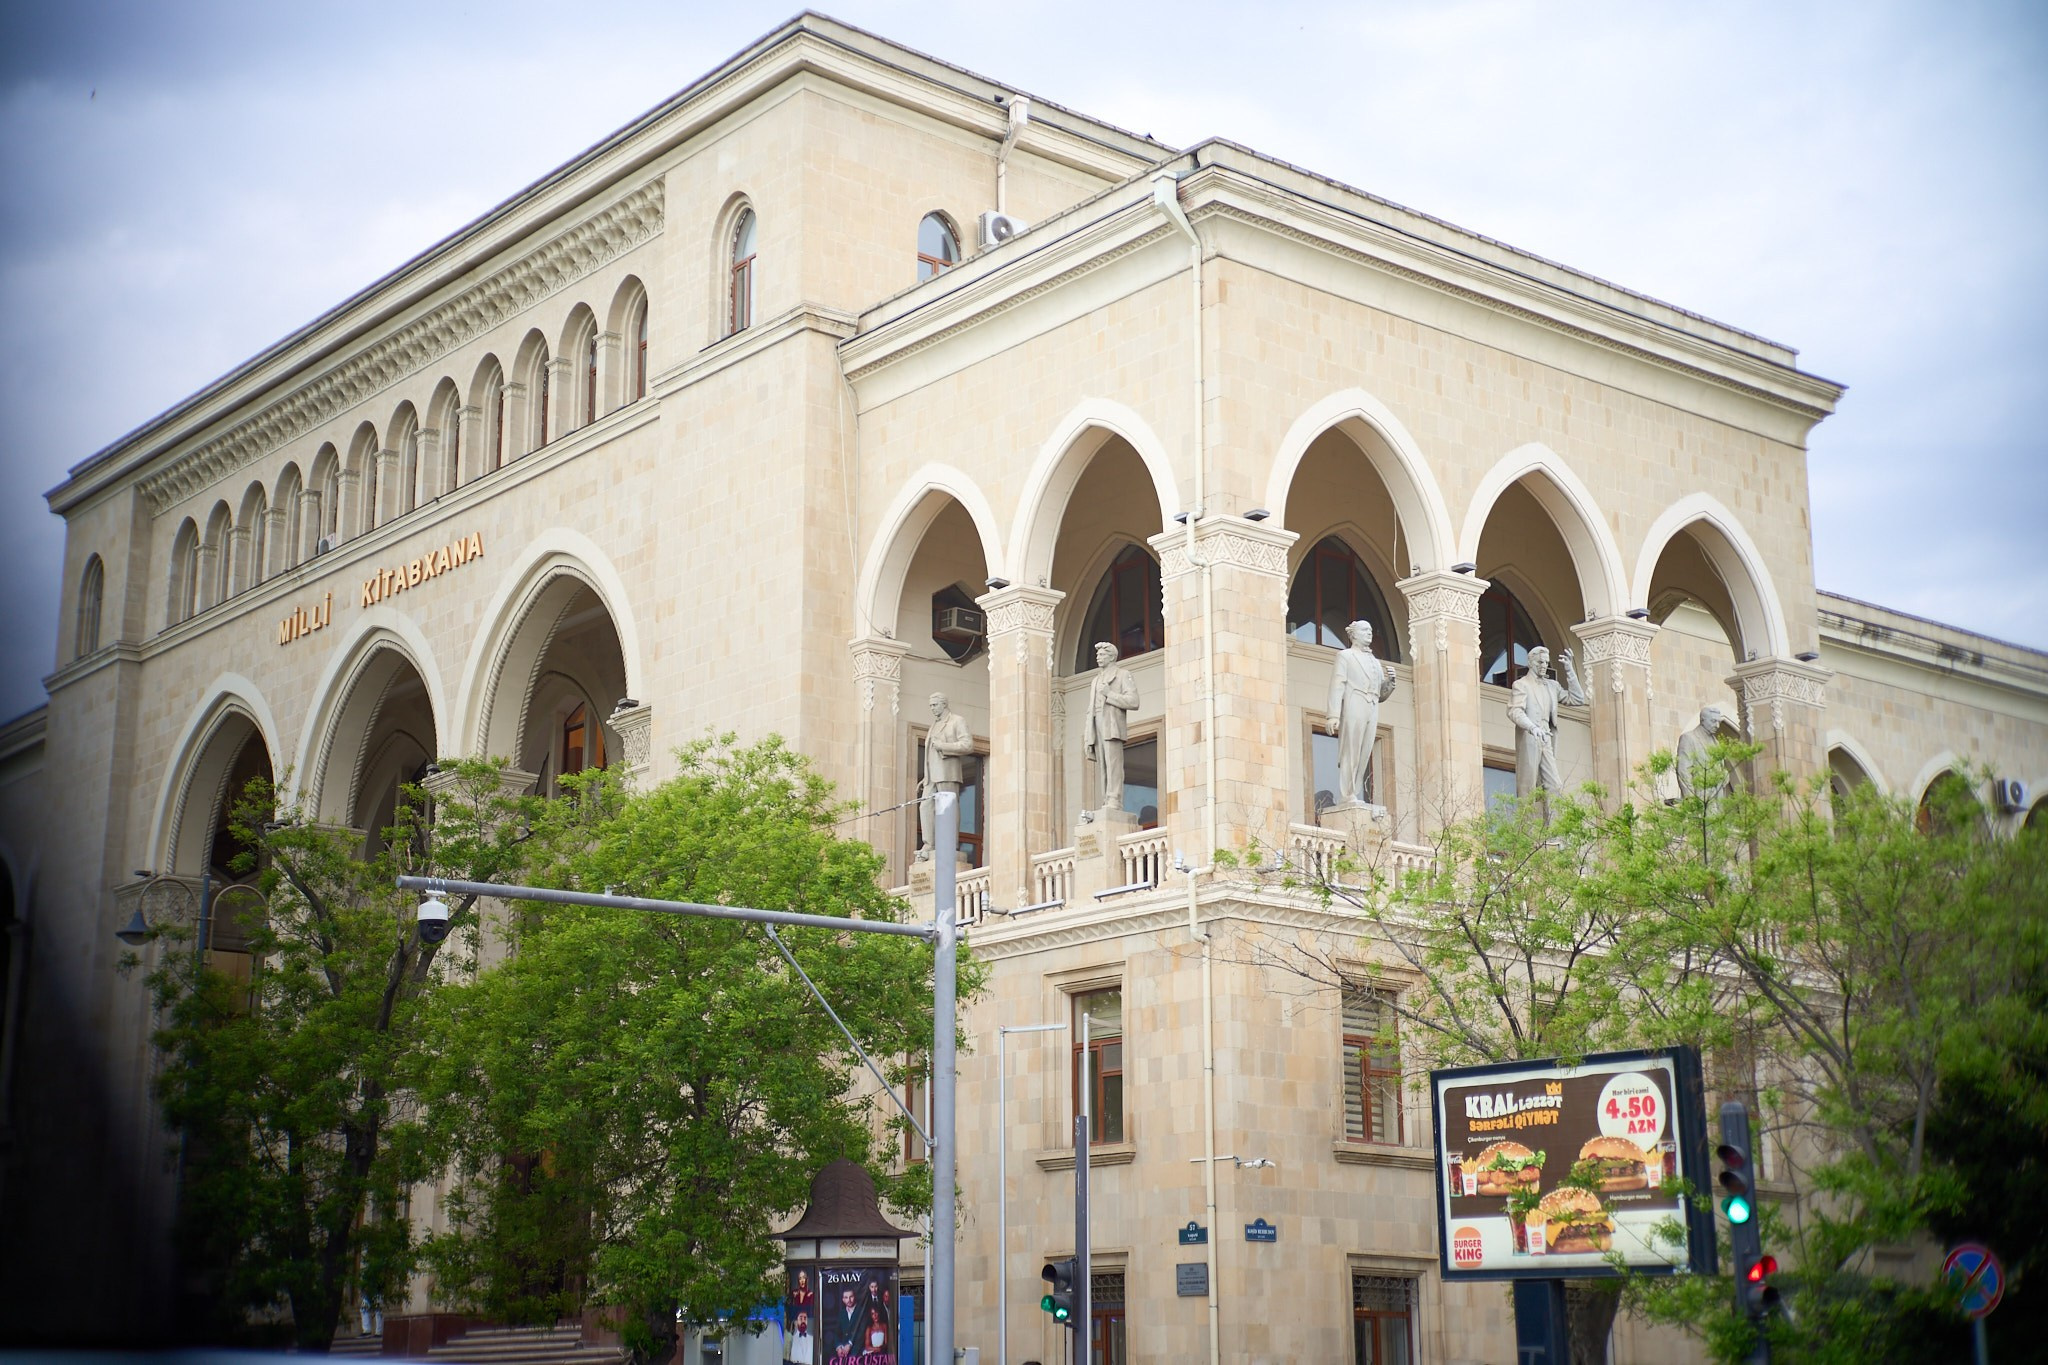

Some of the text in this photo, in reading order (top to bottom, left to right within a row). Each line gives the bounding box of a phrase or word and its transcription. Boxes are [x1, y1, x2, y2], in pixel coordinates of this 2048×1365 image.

[278, 532, 484, 646] MİLLİ KİTABXANA
[1465, 1093, 1518, 1118] KRAL
[1606, 1095, 1655, 1119] 4.50
[1627, 1118, 1656, 1134] AZN
[1454, 1239, 1482, 1248] BURGER
[1455, 1248, 1483, 1261] KING
[827, 1273, 861, 1283] 26 MAY
